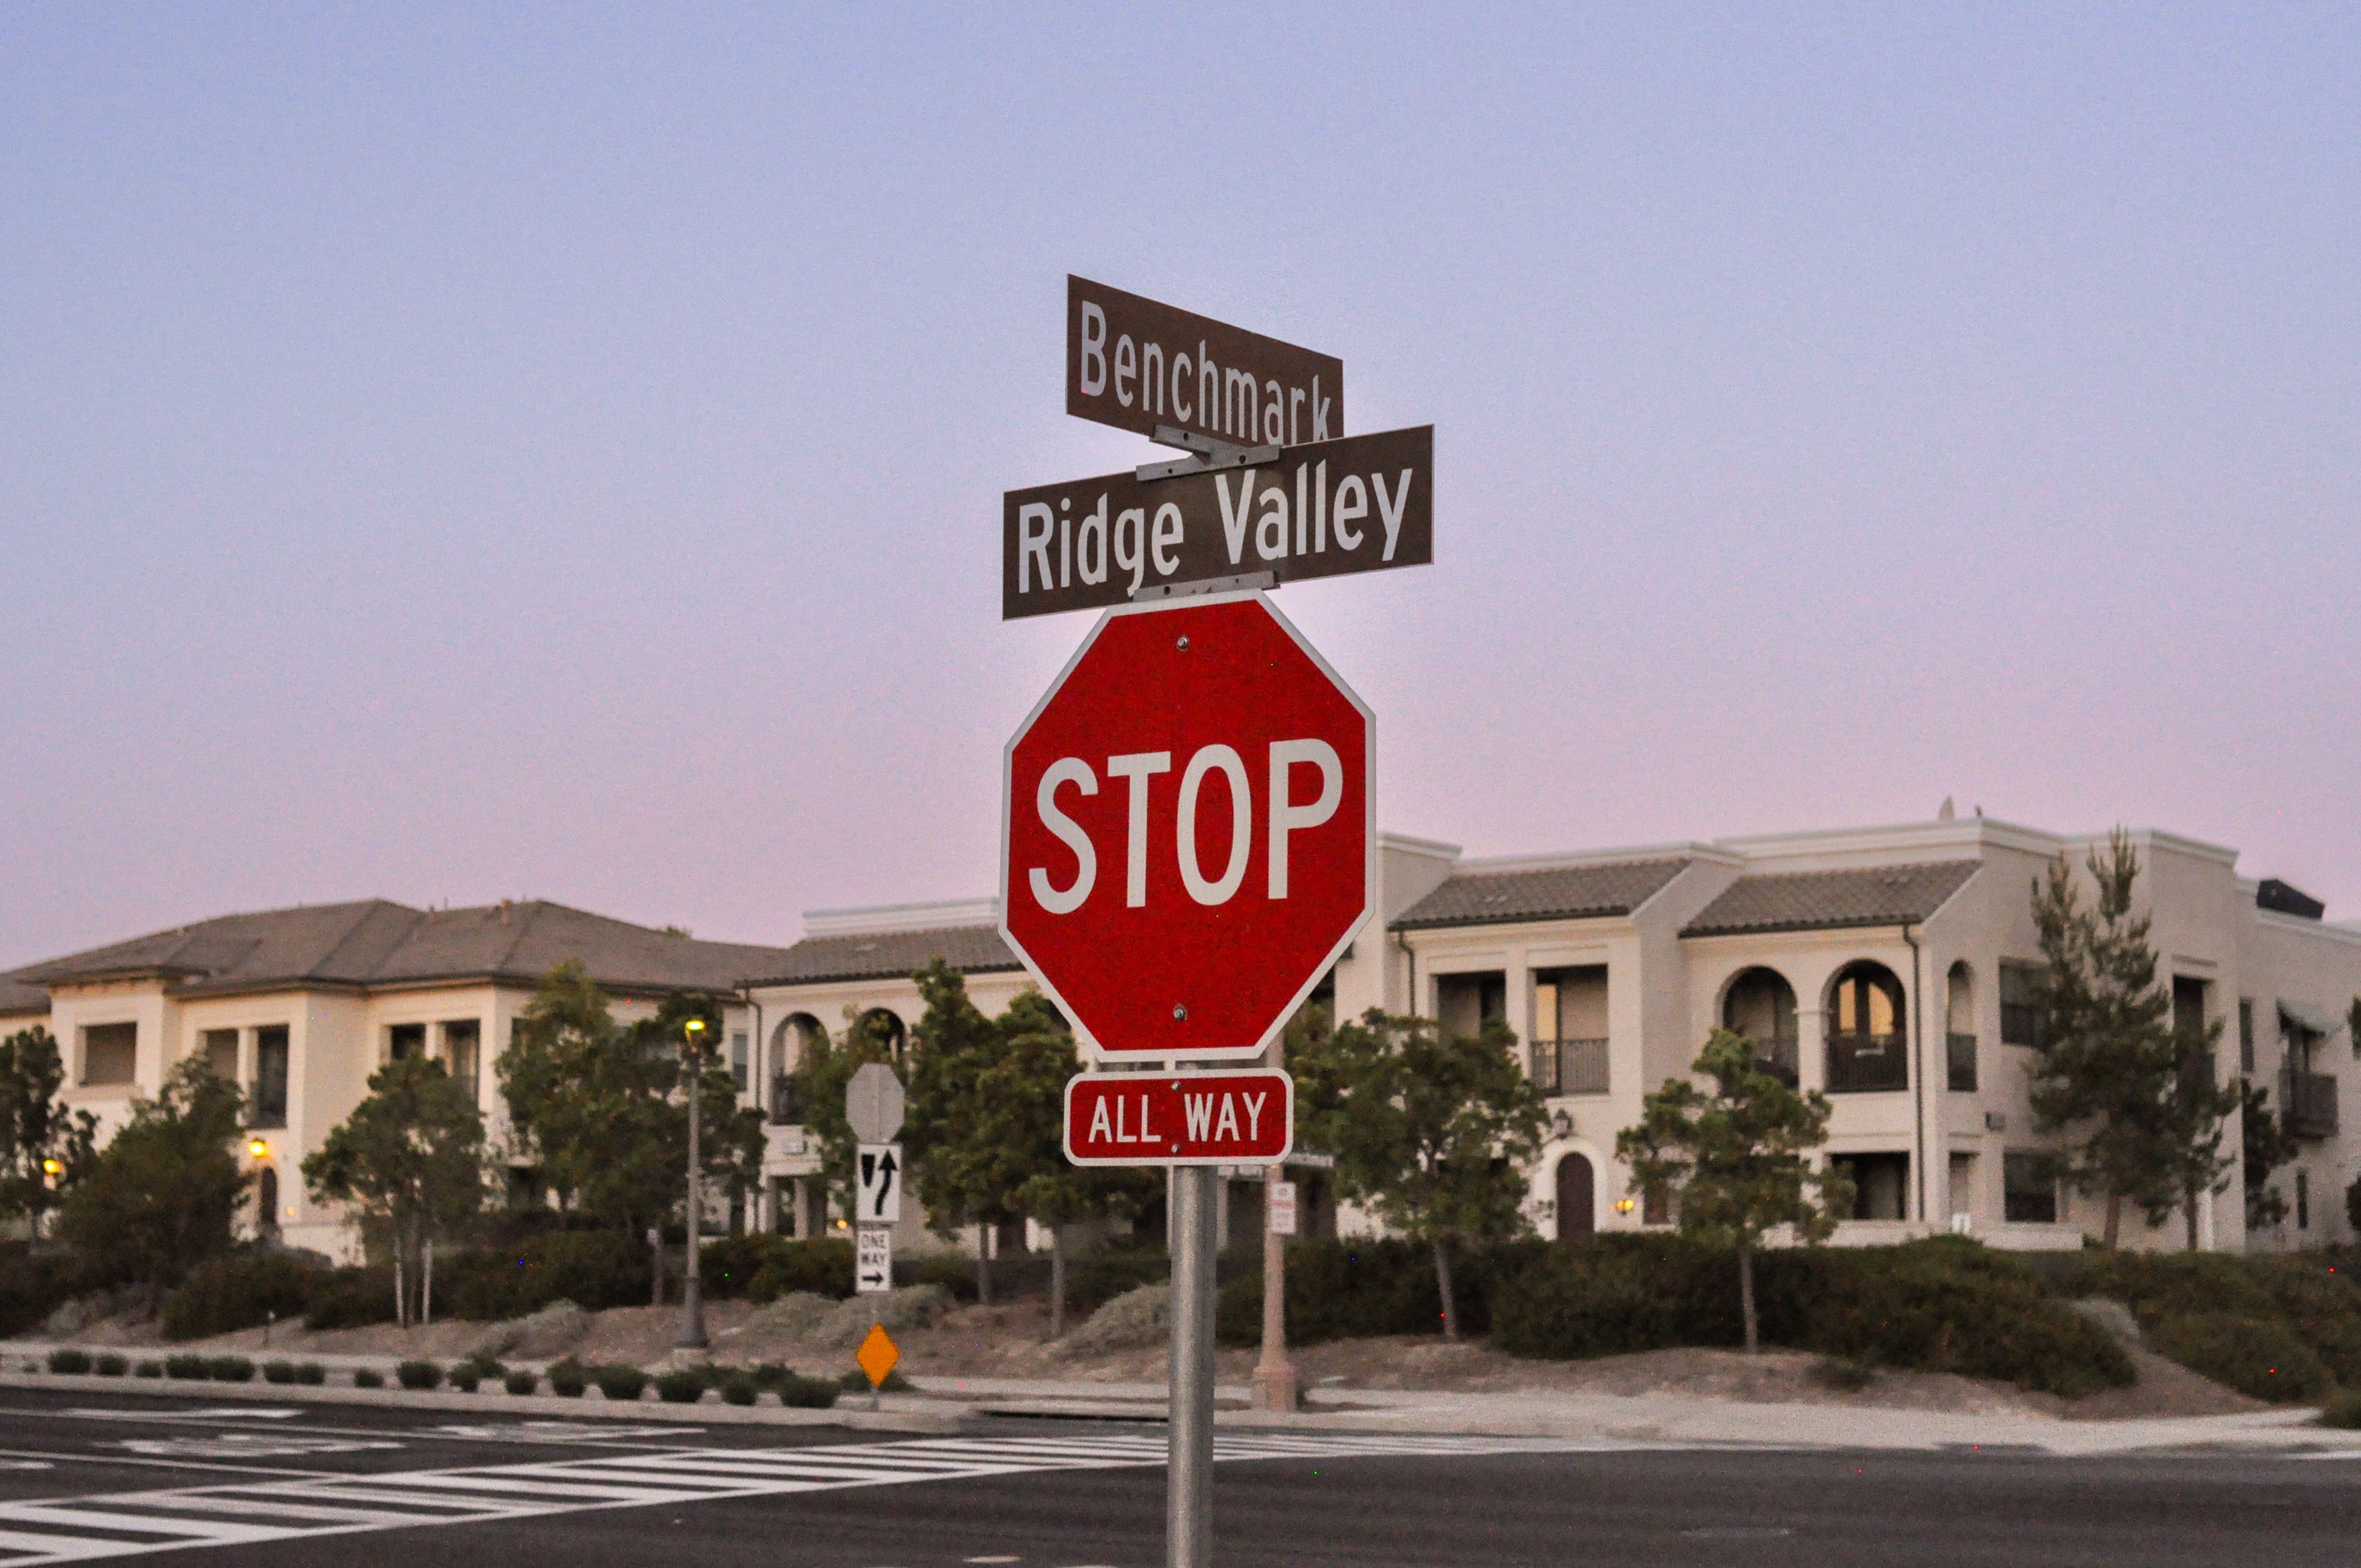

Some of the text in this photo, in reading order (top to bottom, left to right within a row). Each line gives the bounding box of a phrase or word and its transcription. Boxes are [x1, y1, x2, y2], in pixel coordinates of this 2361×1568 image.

[1080, 300, 1331, 445] Benchmark
[1018, 459, 1413, 597] Ridge Valley
[1028, 738, 1344, 915] STOP
[1088, 1092, 1267, 1143] ALL WAY
[860, 1252, 887, 1266] WAY
[861, 1234, 886, 1249] ONE
